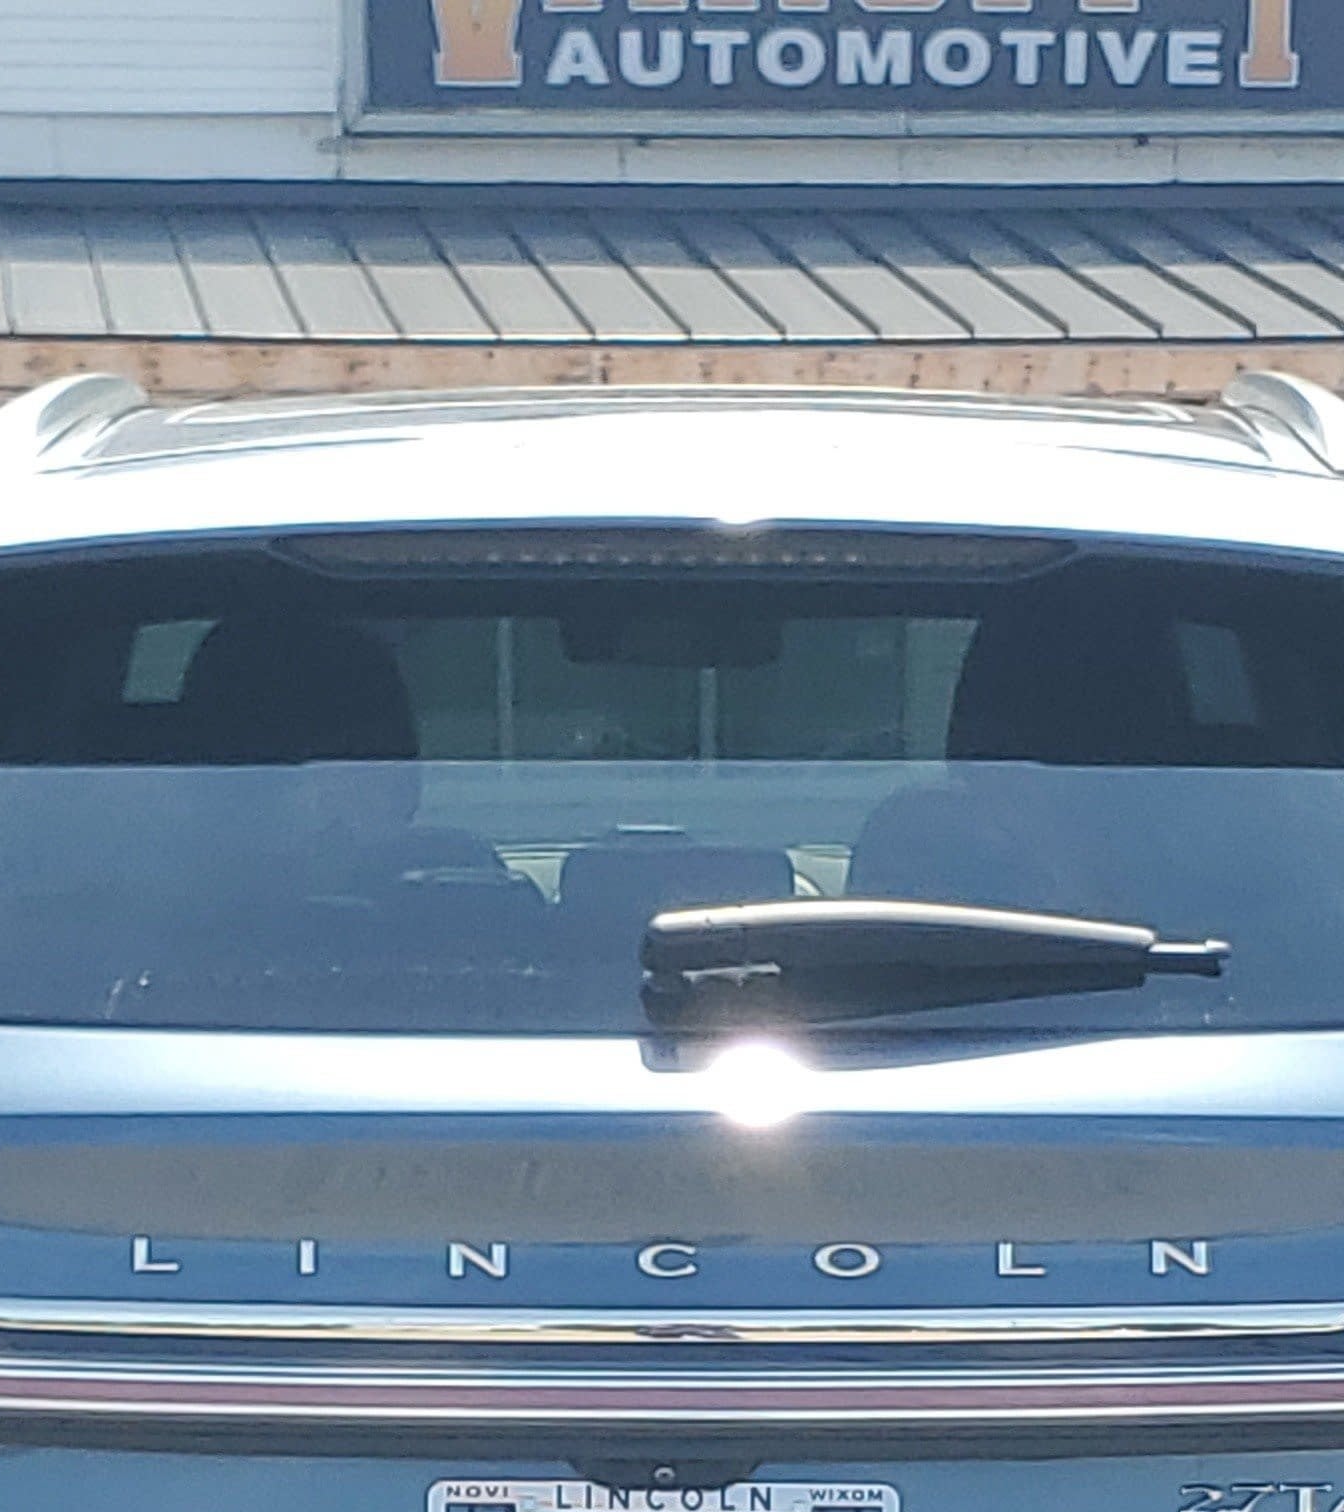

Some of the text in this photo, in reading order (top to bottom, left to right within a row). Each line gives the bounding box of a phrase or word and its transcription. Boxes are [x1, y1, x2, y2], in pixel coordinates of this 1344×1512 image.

[543, 28, 1224, 87] AUTOMOTIVE
[130, 1234, 1212, 1279] LINCOLN
[446, 1484, 884, 1512] NOVI LINCOLN WIXOM
